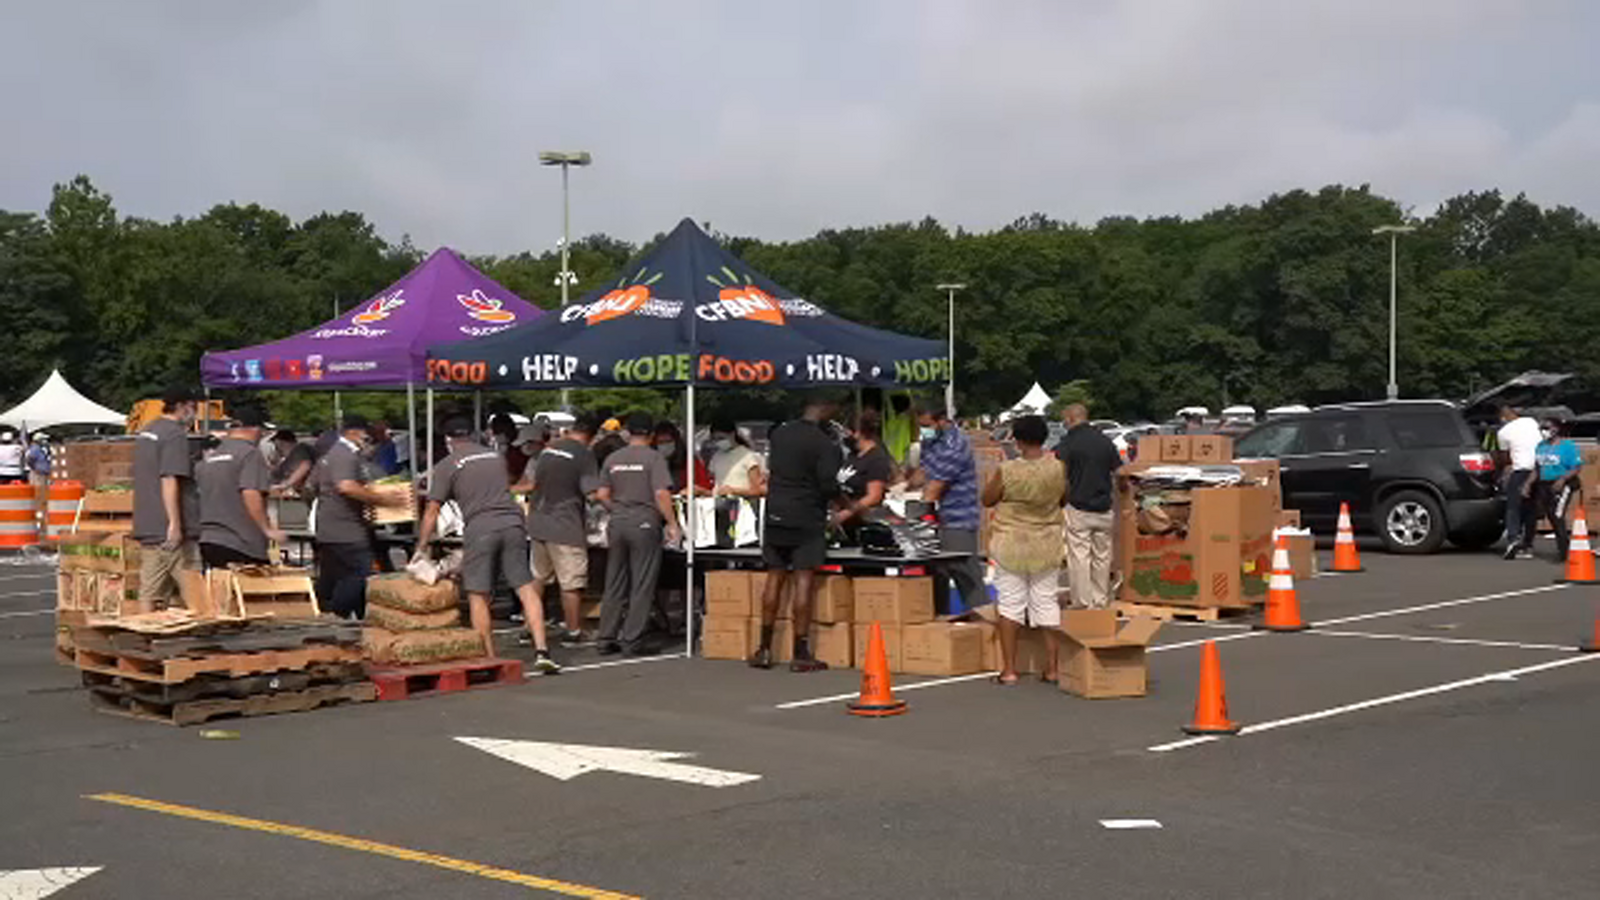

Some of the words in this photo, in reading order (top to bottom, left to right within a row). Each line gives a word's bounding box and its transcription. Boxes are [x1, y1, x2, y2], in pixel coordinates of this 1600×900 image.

[426, 359, 486, 384] FOOD
[522, 354, 578, 381] HELP
[613, 354, 691, 382] HOPE
[699, 354, 774, 384] FOOD
[806, 354, 859, 381] HELP
